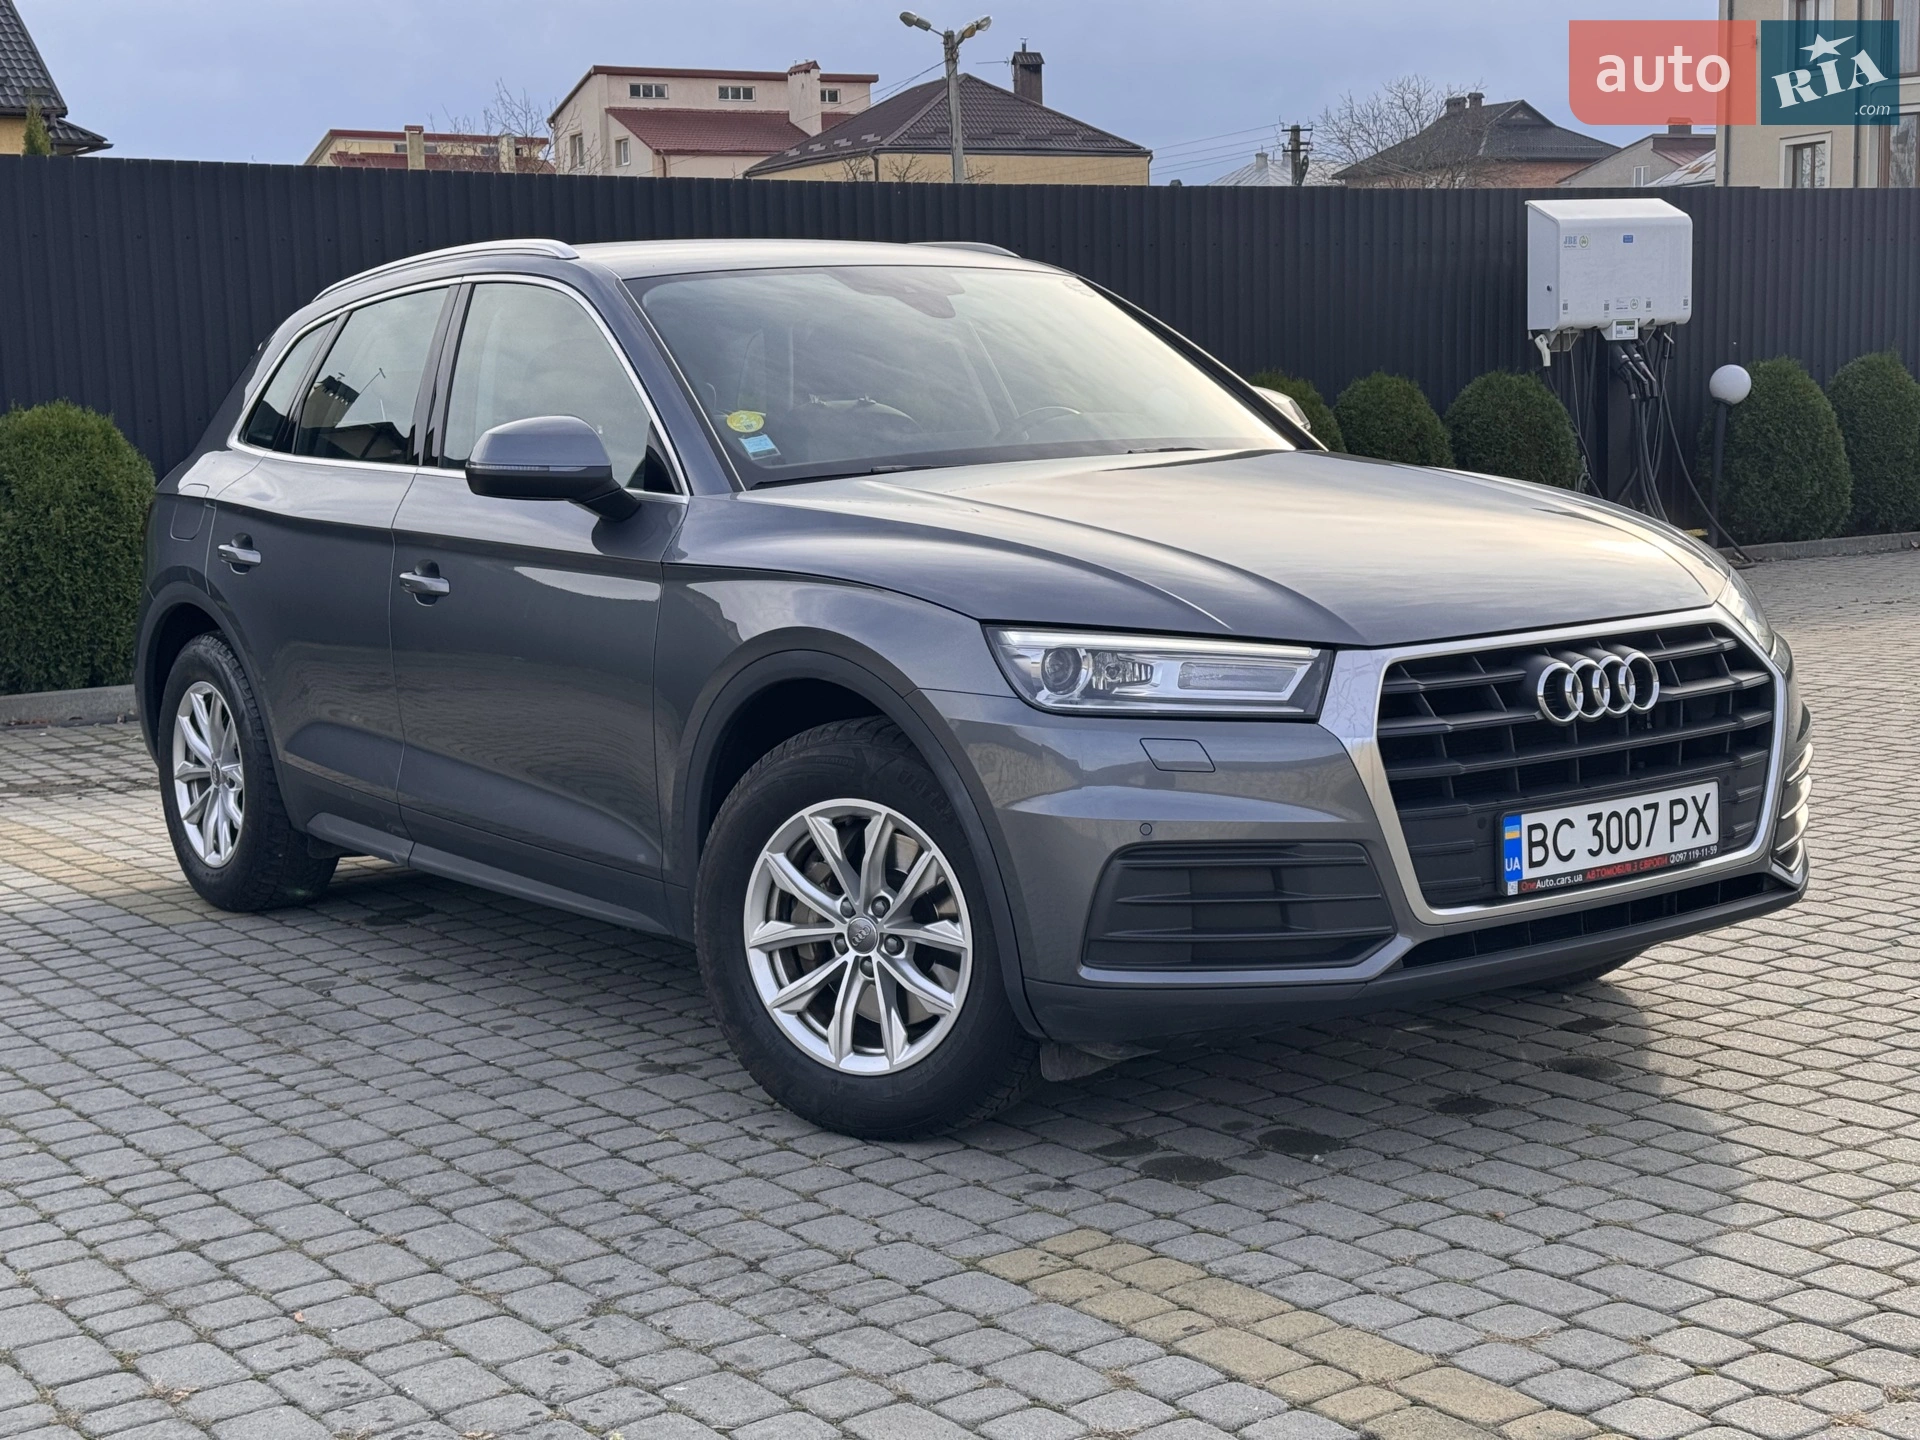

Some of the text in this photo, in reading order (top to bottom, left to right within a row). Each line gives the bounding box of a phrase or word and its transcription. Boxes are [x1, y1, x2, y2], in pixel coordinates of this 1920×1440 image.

[1527, 792, 1712, 869] BC 3007 PX
[1504, 856, 1521, 872] UA
[1521, 873, 1583, 891] OneAuto.cars.ua
[1688, 845, 1717, 860] 119-11-59
